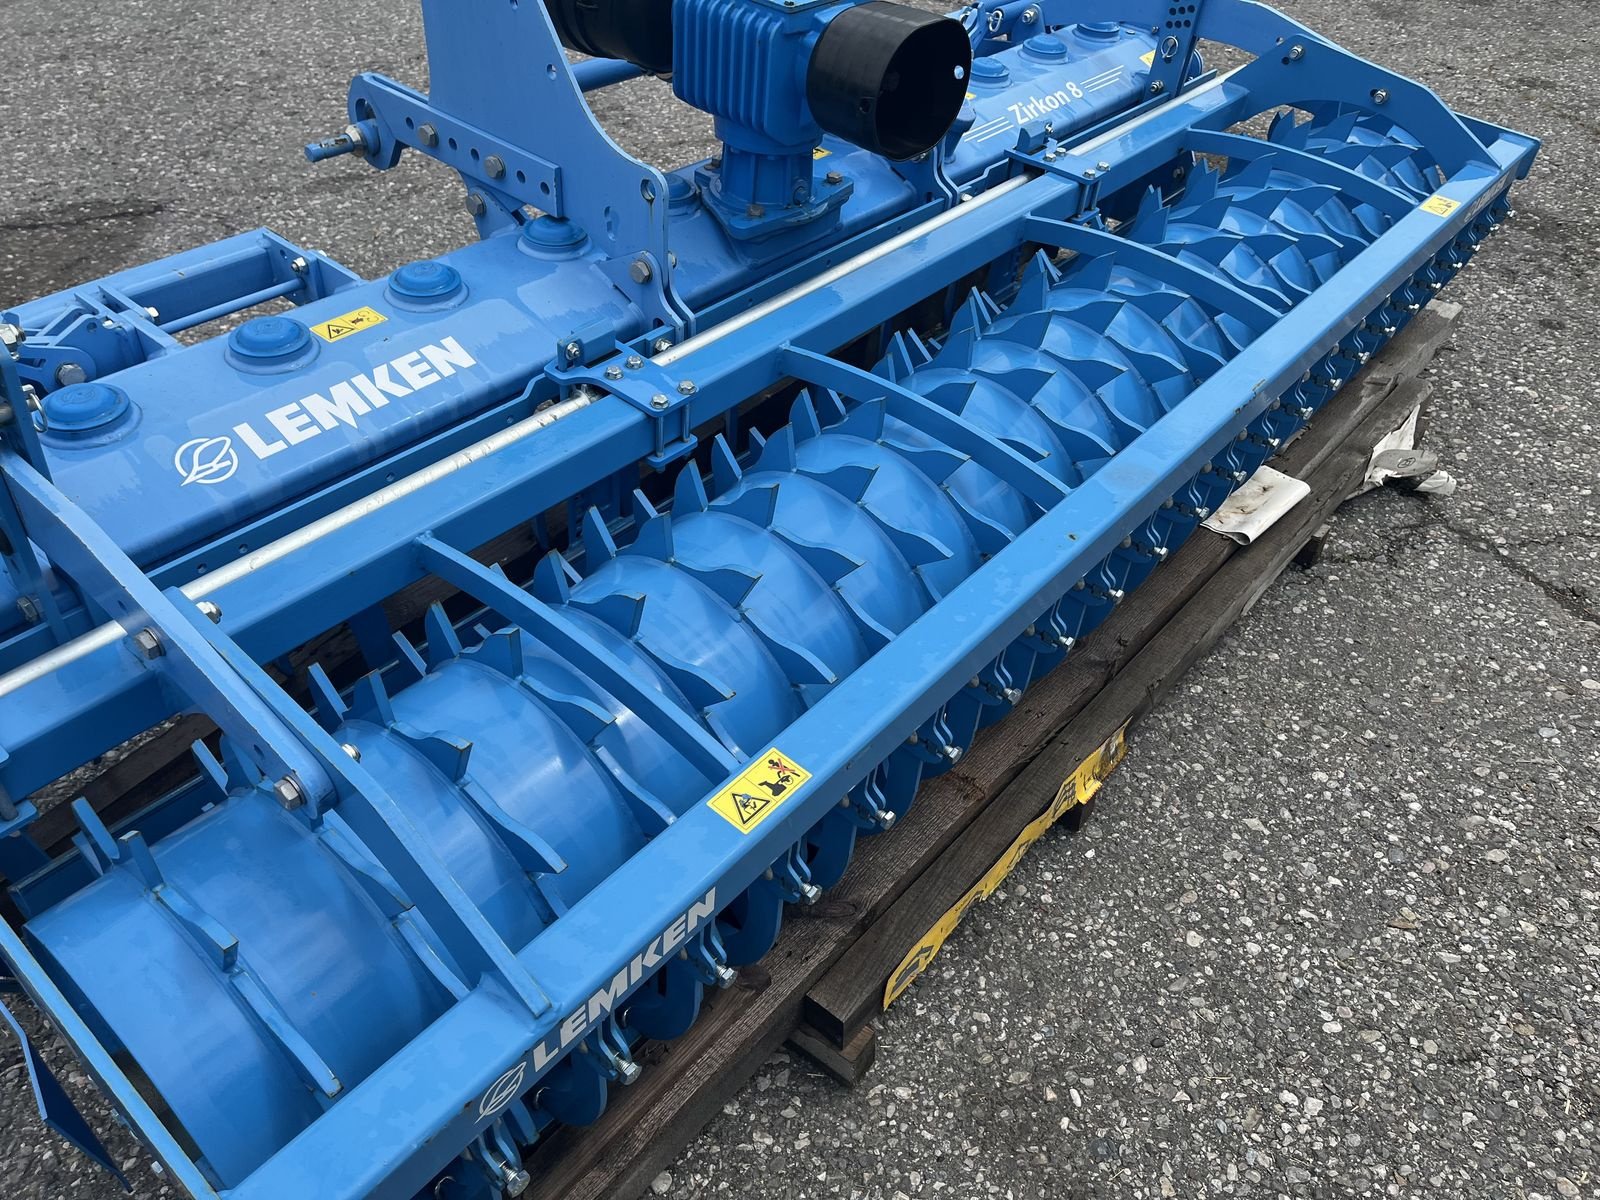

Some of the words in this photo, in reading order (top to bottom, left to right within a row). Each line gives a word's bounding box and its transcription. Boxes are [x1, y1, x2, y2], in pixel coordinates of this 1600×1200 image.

[1007, 89, 1071, 125] Zirkon
[1065, 81, 1084, 99] 8
[232, 335, 477, 460] LEMKEN
[533, 887, 716, 1073] LEMKEN
